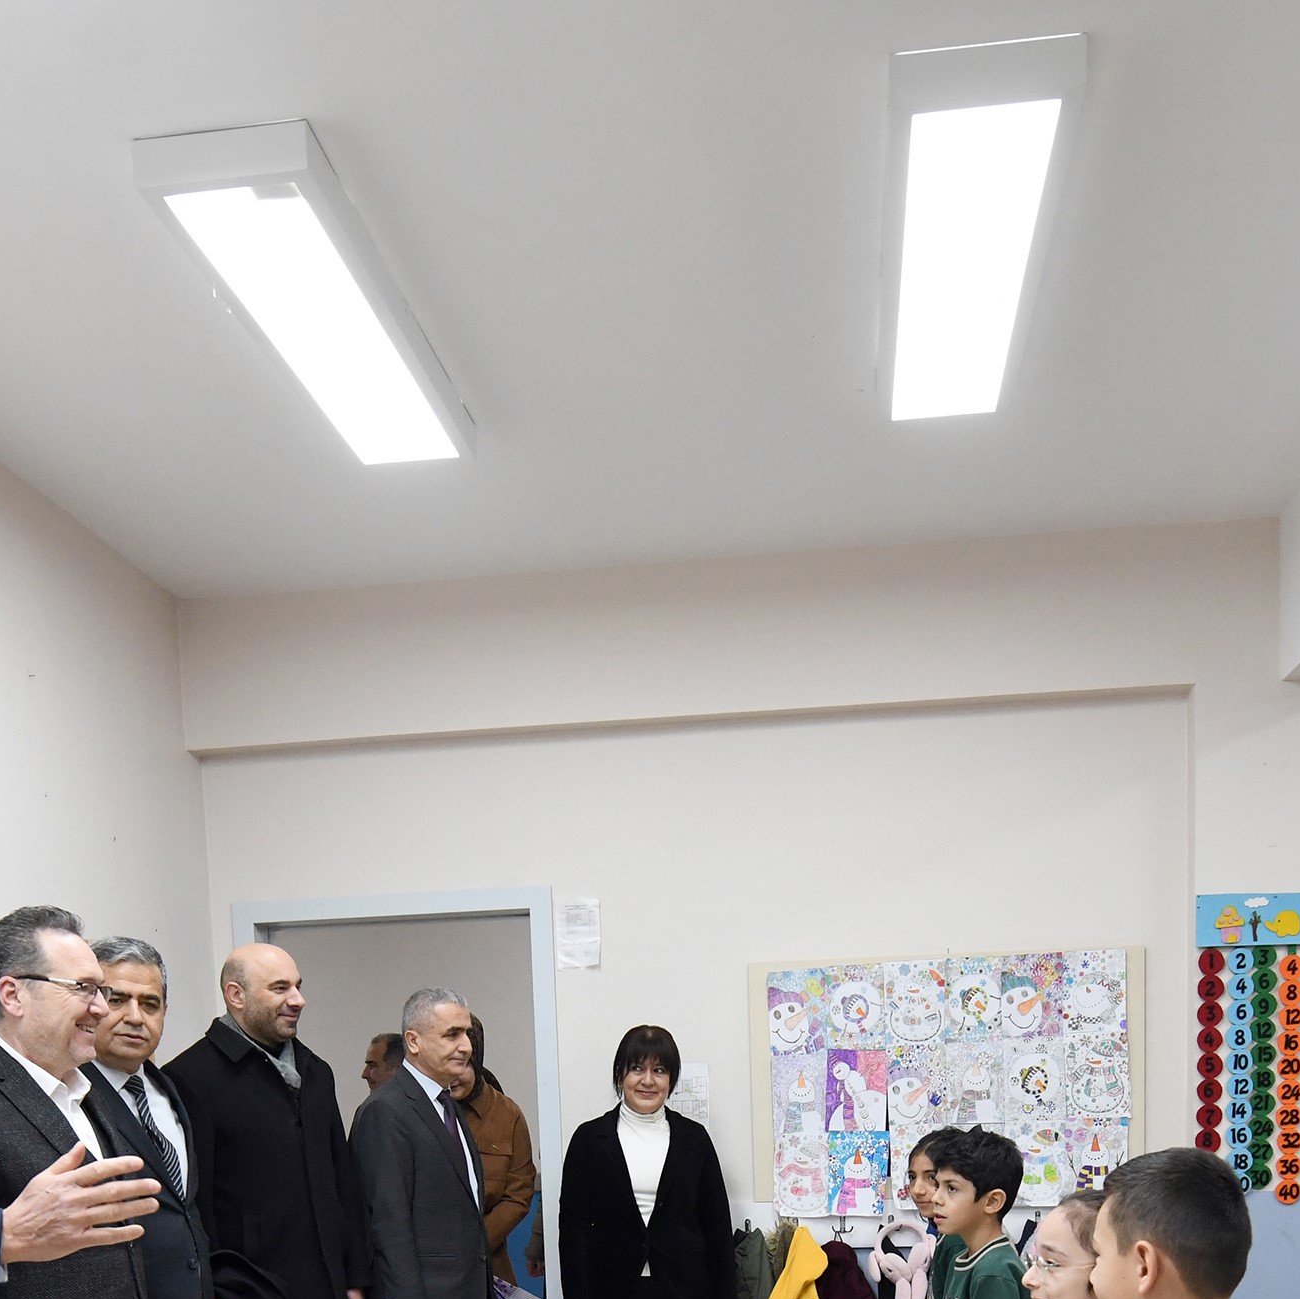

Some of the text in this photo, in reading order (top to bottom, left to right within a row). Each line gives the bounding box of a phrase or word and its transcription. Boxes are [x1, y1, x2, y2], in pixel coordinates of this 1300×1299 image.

[1209, 954, 1214, 968] 1
[1236, 953, 1246, 969] 2
[1258, 950, 1269, 965] 3
[1287, 959, 1298, 975] 4
[1205, 981, 1215, 996] 2
[1236, 978, 1247, 994] 4
[1259, 973, 1269, 989] 6
[1286, 984, 1297, 1000] 8
[1206, 1006, 1215, 1021] 3
[1236, 1004, 1247, 1019] 6
[1259, 998, 1269, 1014] 9
[1286, 1009, 1300, 1025] 12
[1205, 1032, 1214, 1046] 4
[1235, 1030, 1245, 1045] 8
[1256, 1022, 1271, 1038] 12
[1284, 1034, 1298, 1050] 16
[1205, 1057, 1214, 1072] 5
[1233, 1054, 1248, 1070] 10
[1257, 1046, 1273, 1062] 15
[1281, 1059, 1300, 1074] 20
[1204, 1083, 1213, 1098] 6
[1234, 1079, 1249, 1094] 12
[1257, 1071, 1270, 1087] 18
[1282, 1084, 1300, 1100] 24
[1206, 1110, 1215, 1124] 7
[1231, 1103, 1246, 1119] 14
[1254, 1095, 1268, 1110] 21
[1280, 1109, 1299, 1125] 28
[1202, 1132, 1212, 1147] 8
[1231, 1128, 1247, 1144] 16
[1254, 1121, 1273, 1136] 24
[1281, 1133, 1300, 1149] 32
[1234, 1154, 1248, 1169] 18
[1253, 1145, 1271, 1159] 27
[1280, 1159, 1299, 1175] 36
[1241, 1177, 1249, 1191] 0
[1251, 1170, 1269, 1186] 30
[1279, 1184, 1299, 1200] 40
